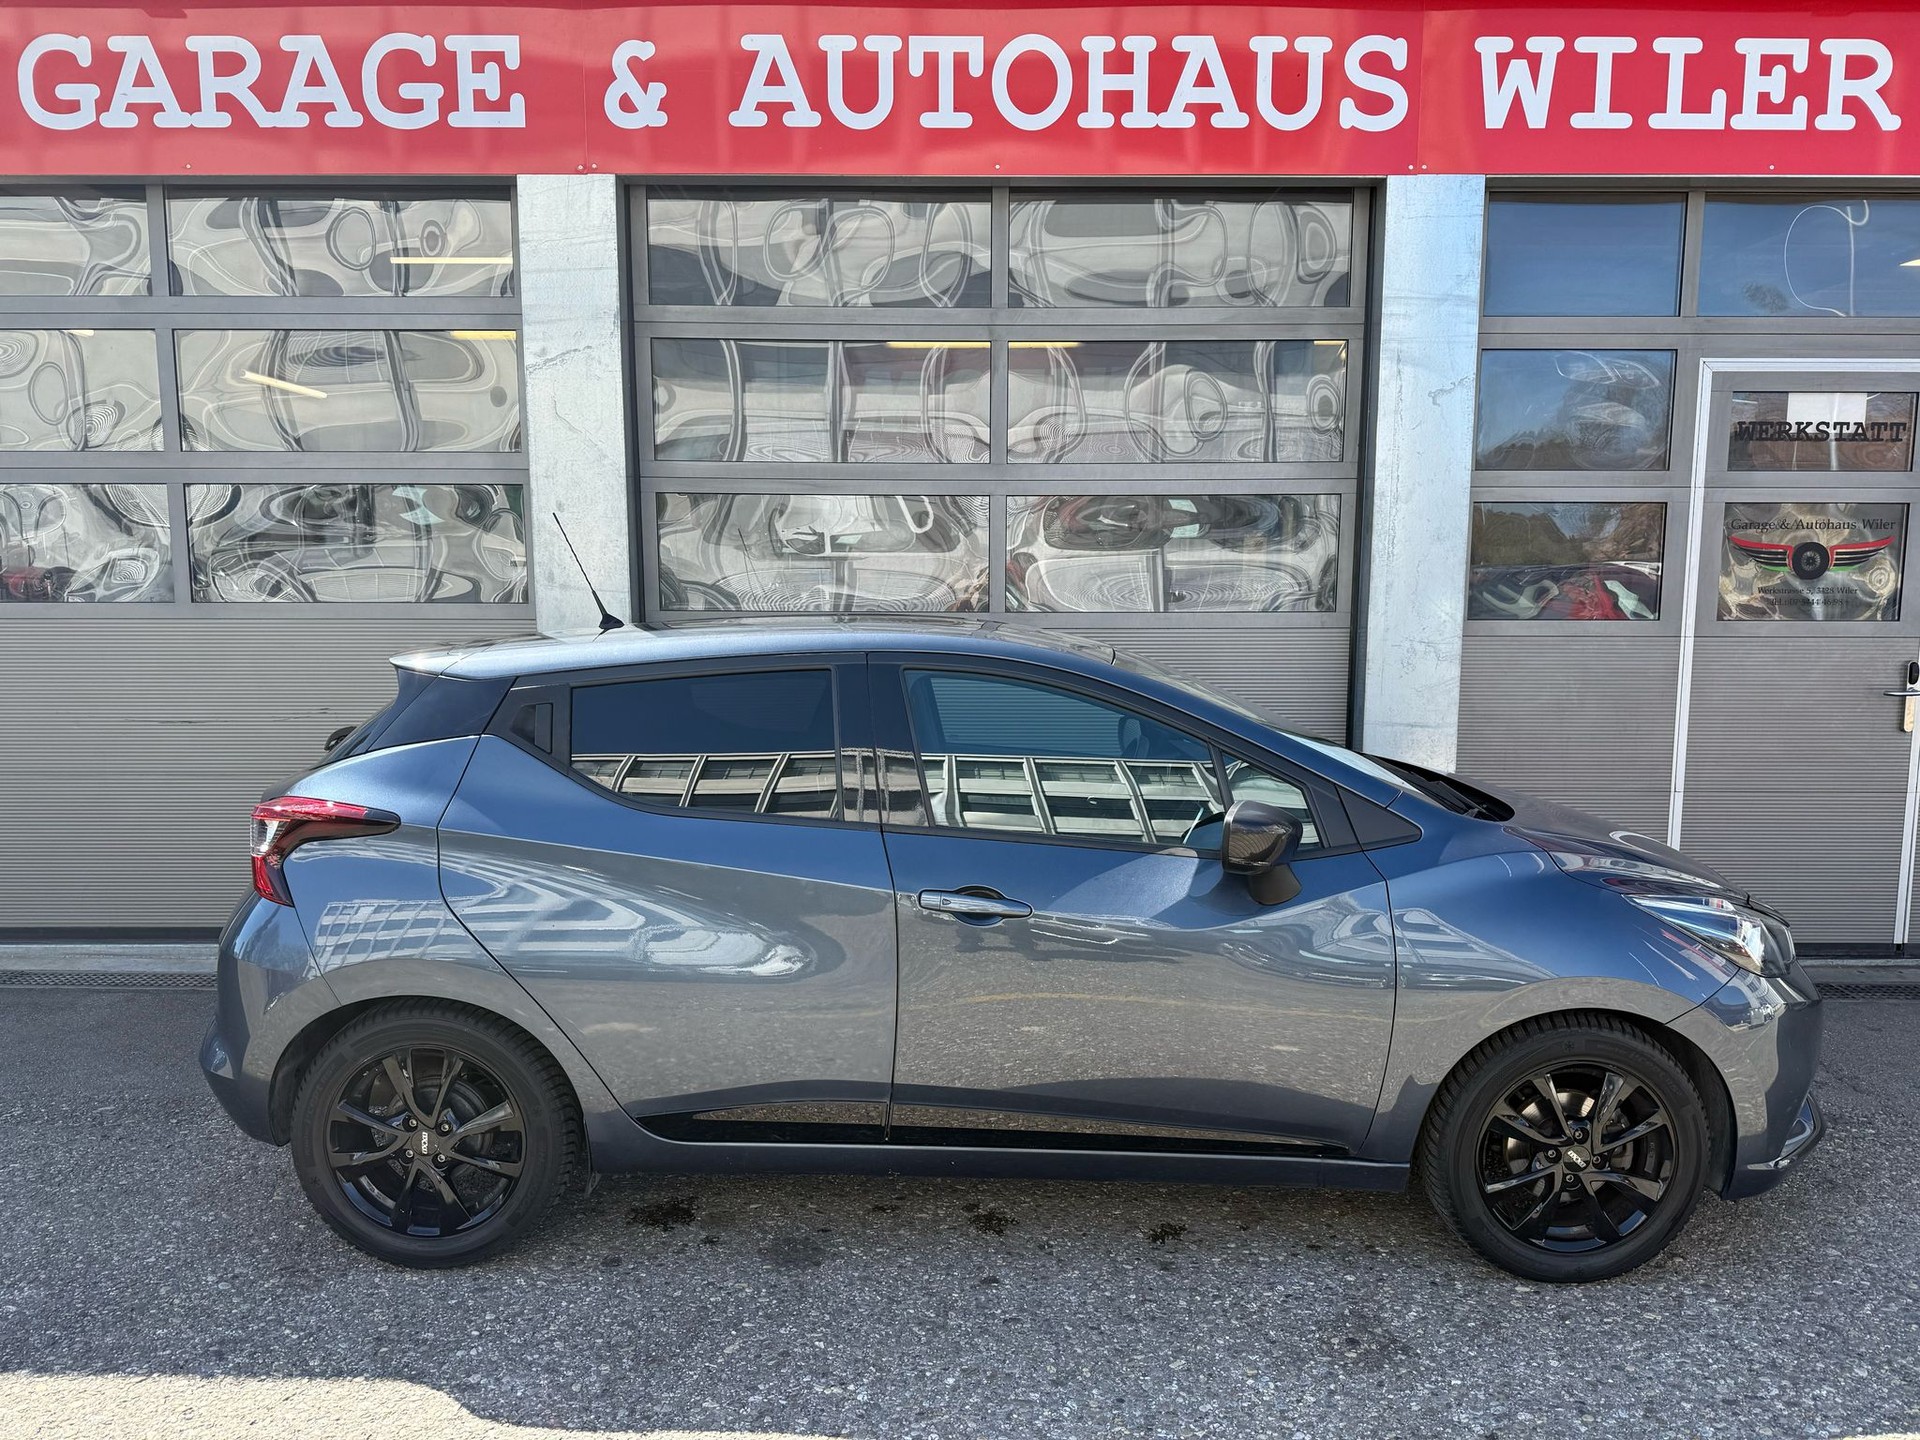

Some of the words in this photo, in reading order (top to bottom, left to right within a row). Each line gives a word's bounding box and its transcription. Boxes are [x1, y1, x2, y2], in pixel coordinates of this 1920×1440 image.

[18, 33, 526, 130] GARAGE
[604, 40, 667, 130] &
[729, 34, 1408, 131] AUTOHAUS
[1475, 37, 1902, 131] WILER
[1735, 420, 1907, 443] WERKSTATT
[1731, 518, 1776, 533] Garage
[1795, 518, 1857, 531] Autohaus
[1862, 518, 1896, 531] Wiler
[1837, 586, 1858, 595] Wiler
